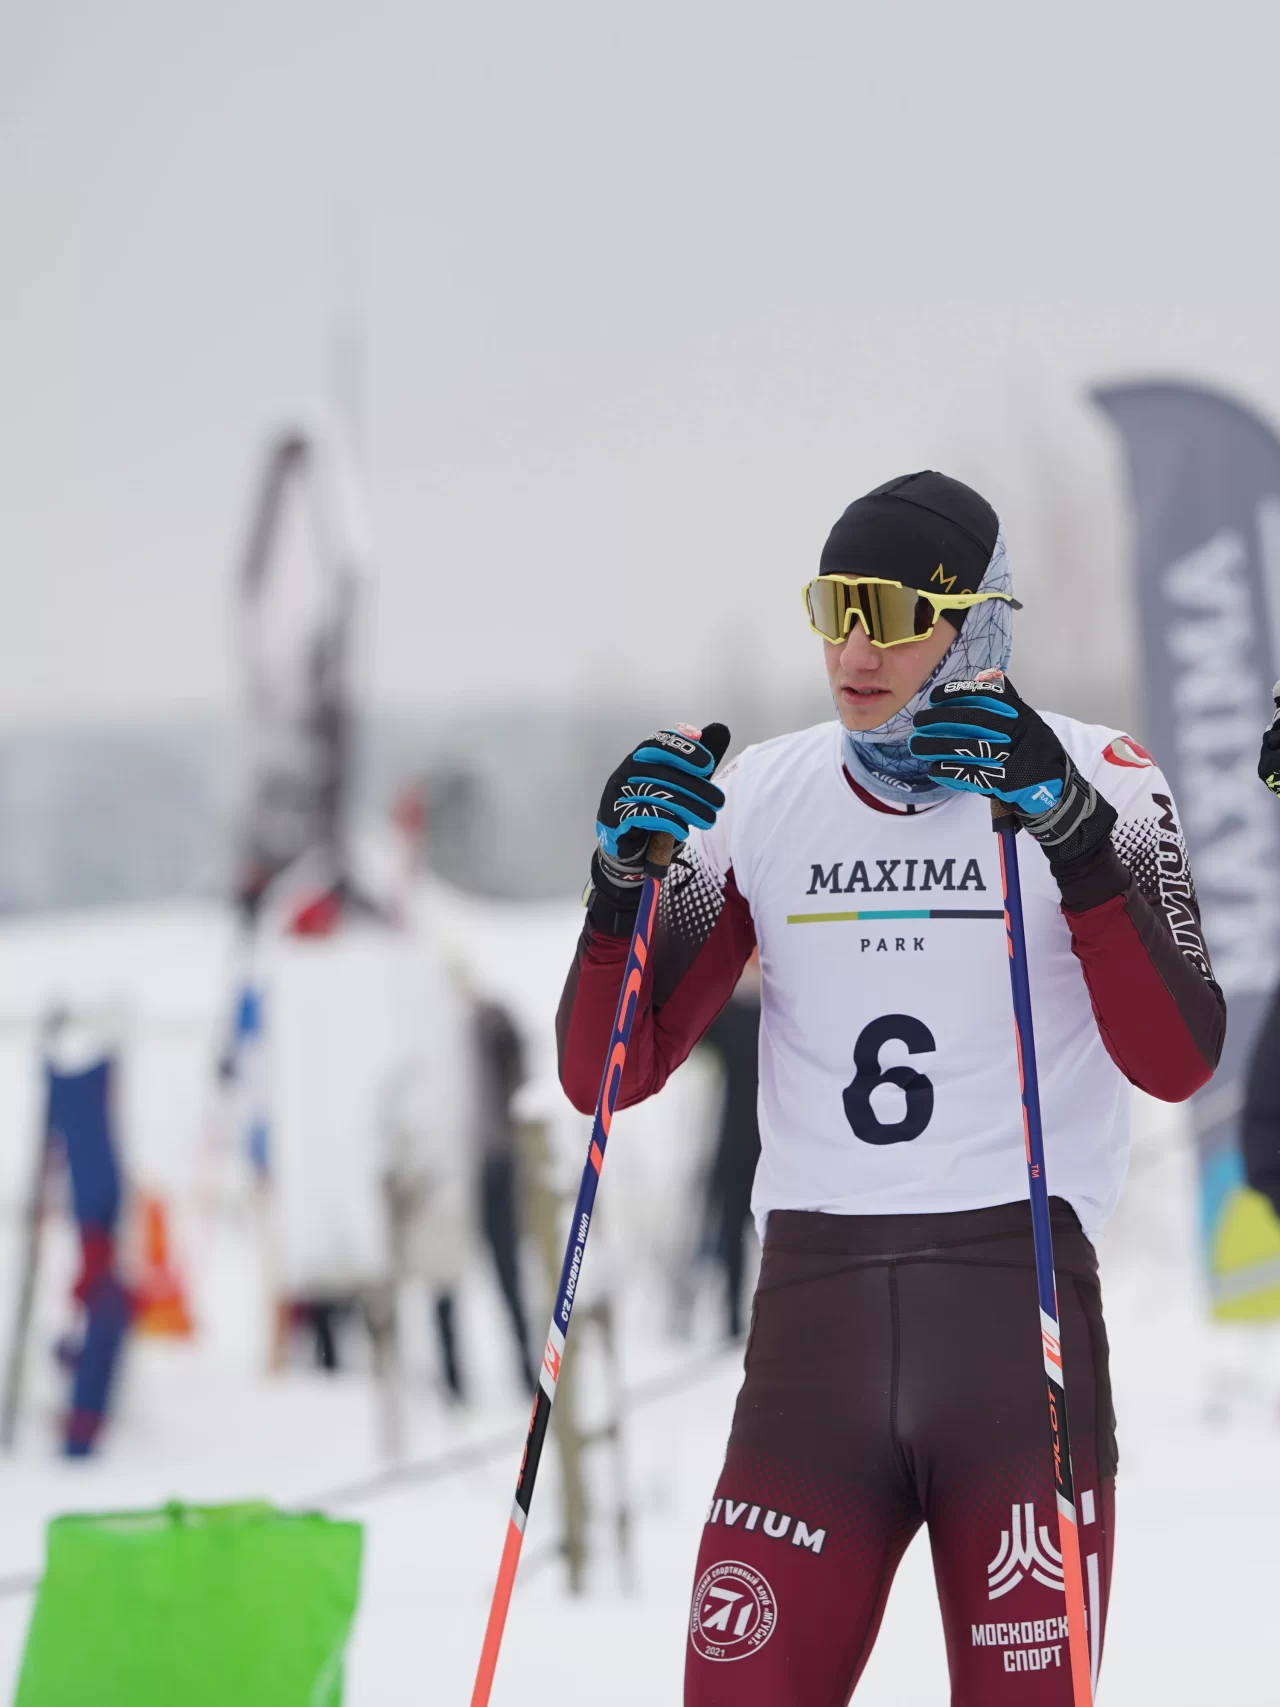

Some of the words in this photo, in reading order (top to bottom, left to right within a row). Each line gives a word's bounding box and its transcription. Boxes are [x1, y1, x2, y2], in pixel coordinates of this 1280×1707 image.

[806, 858, 987, 895] MAXIMA
[860, 937, 925, 952] PARK
[842, 1013, 936, 1146] 6
[577, 1212, 590, 1244] UHM
[565, 1247, 583, 1300] CARBON
[561, 1300, 571, 1322] 2.0
[704, 1498, 827, 1554] IVIUM
[971, 1605, 1089, 1647] МОСКОВСК
[705, 1645, 726, 1658] 2021
[1003, 1645, 1063, 1673] СПОРТ
